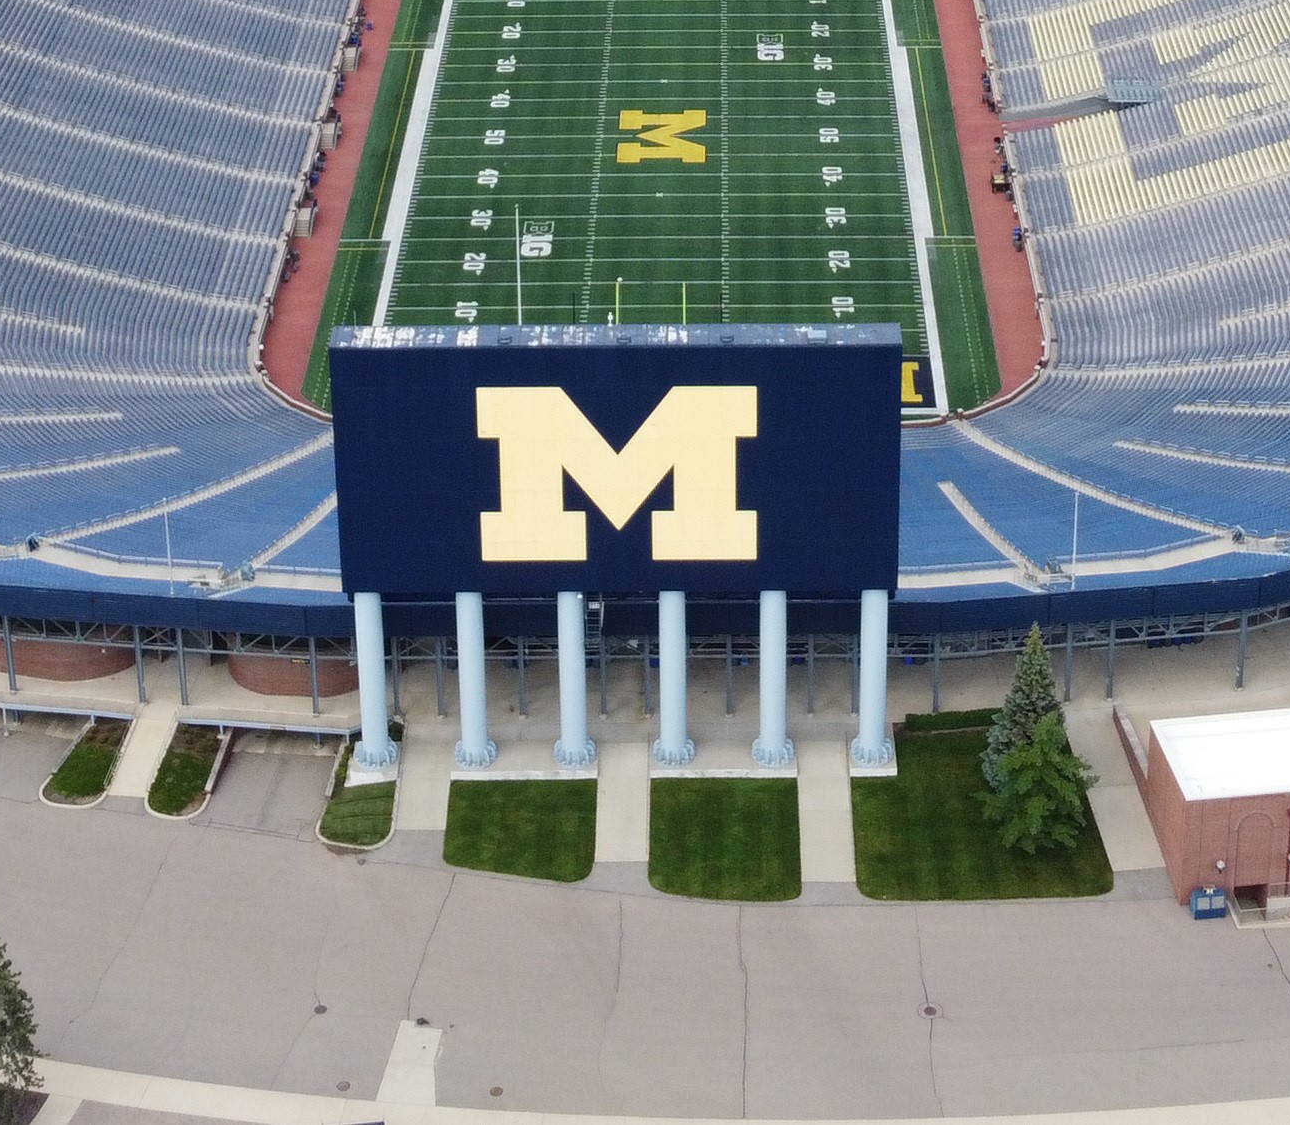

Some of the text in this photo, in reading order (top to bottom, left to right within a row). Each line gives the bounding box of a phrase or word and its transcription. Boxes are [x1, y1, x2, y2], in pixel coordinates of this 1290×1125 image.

[501, 25, 522, 39] 20
[810, 24, 830, 38] 20
[496, 58, 517, 73] 30
[813, 56, 833, 71] 30
[490, 93, 511, 108] 40
[816, 91, 836, 106] 40
[484, 129, 506, 145] 50
[615, 108, 707, 163] M
[818, 127, 840, 143] 50
[477, 168, 500, 184] 40
[821, 166, 843, 182] 40
[470, 209, 493, 226] 30
[824, 207, 847, 224] 30
[462, 252, 486, 271] 20
[827, 250, 851, 268] 20
[454, 301, 479, 317] 10
[831, 296, 855, 313] 10
[475, 385, 758, 562] M
